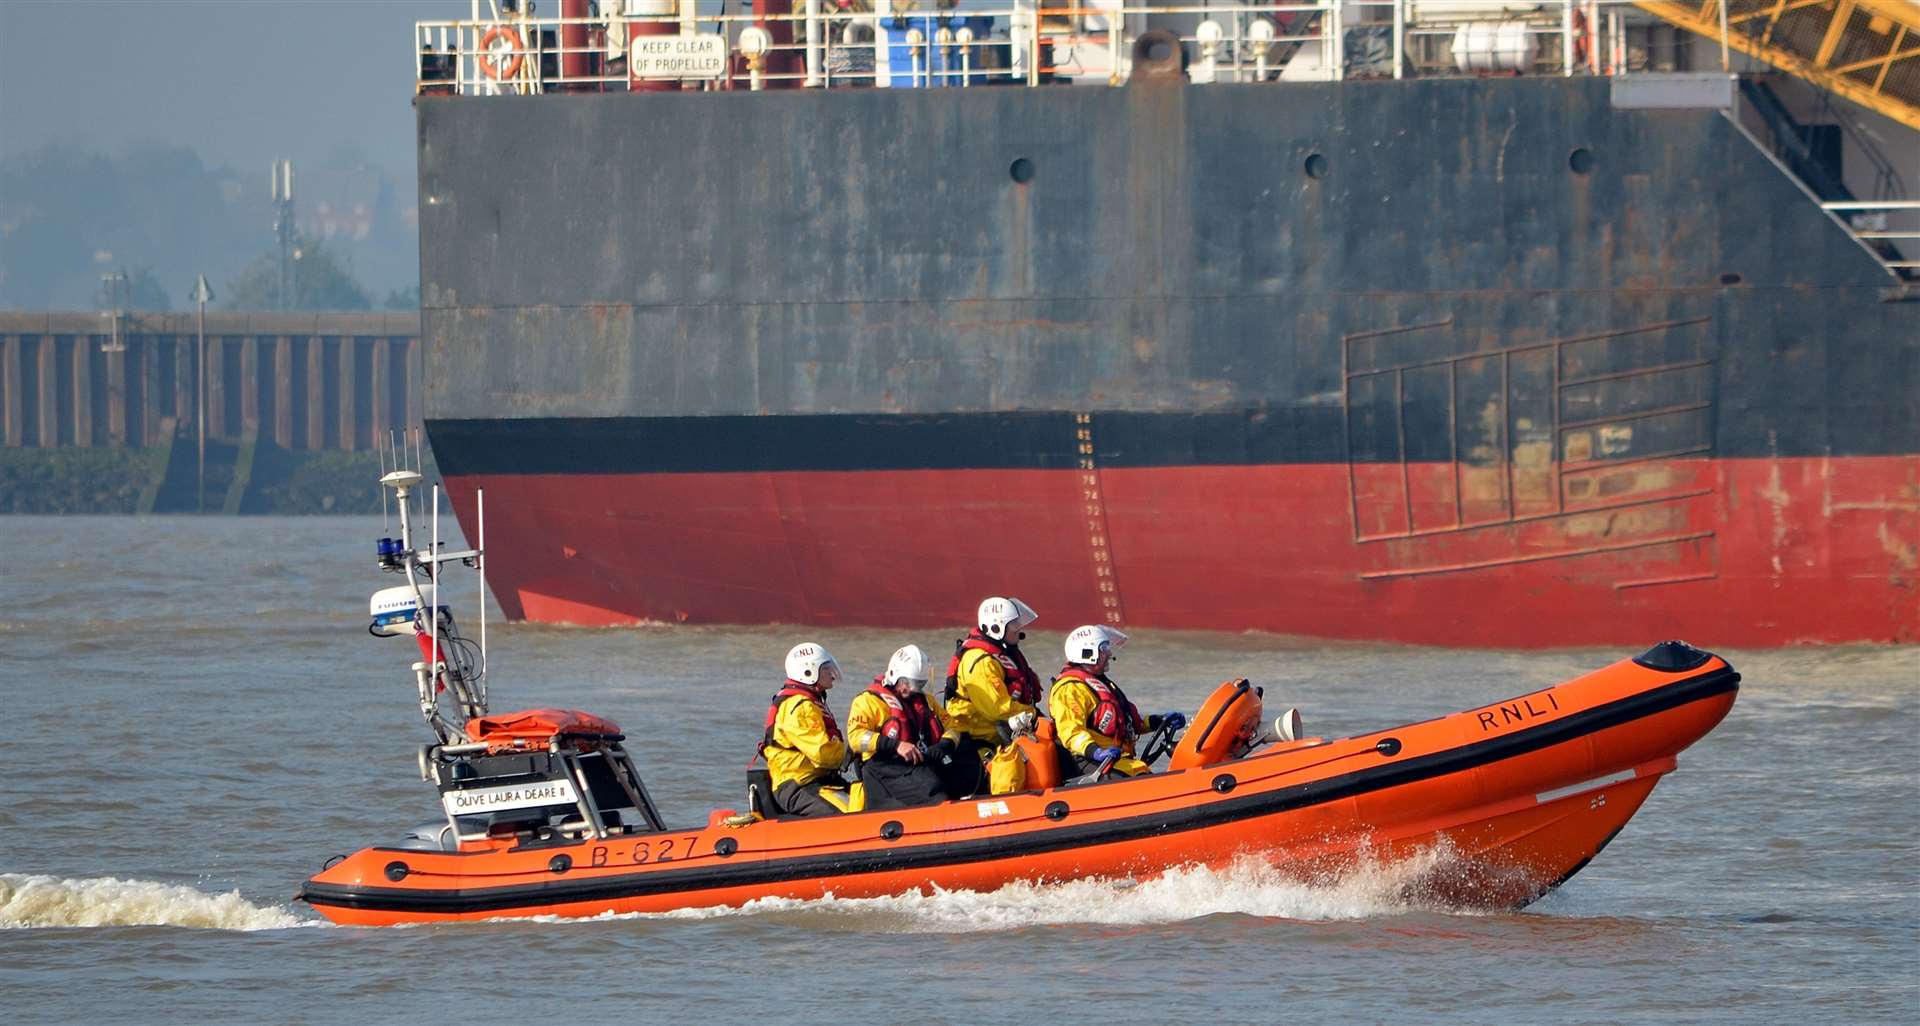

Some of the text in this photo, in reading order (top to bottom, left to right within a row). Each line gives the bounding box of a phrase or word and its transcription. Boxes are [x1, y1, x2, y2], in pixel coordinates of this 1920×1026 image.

[643, 41, 713, 53] KEEP CLEAR
[636, 58, 720, 70] OF PROPELLER
[1477, 694, 1559, 731] RNLI
[456, 796, 485, 808] OLIVE
[488, 791, 521, 804] LAURA
[525, 787, 556, 800] DEARE
[592, 837, 698, 867] B-827
